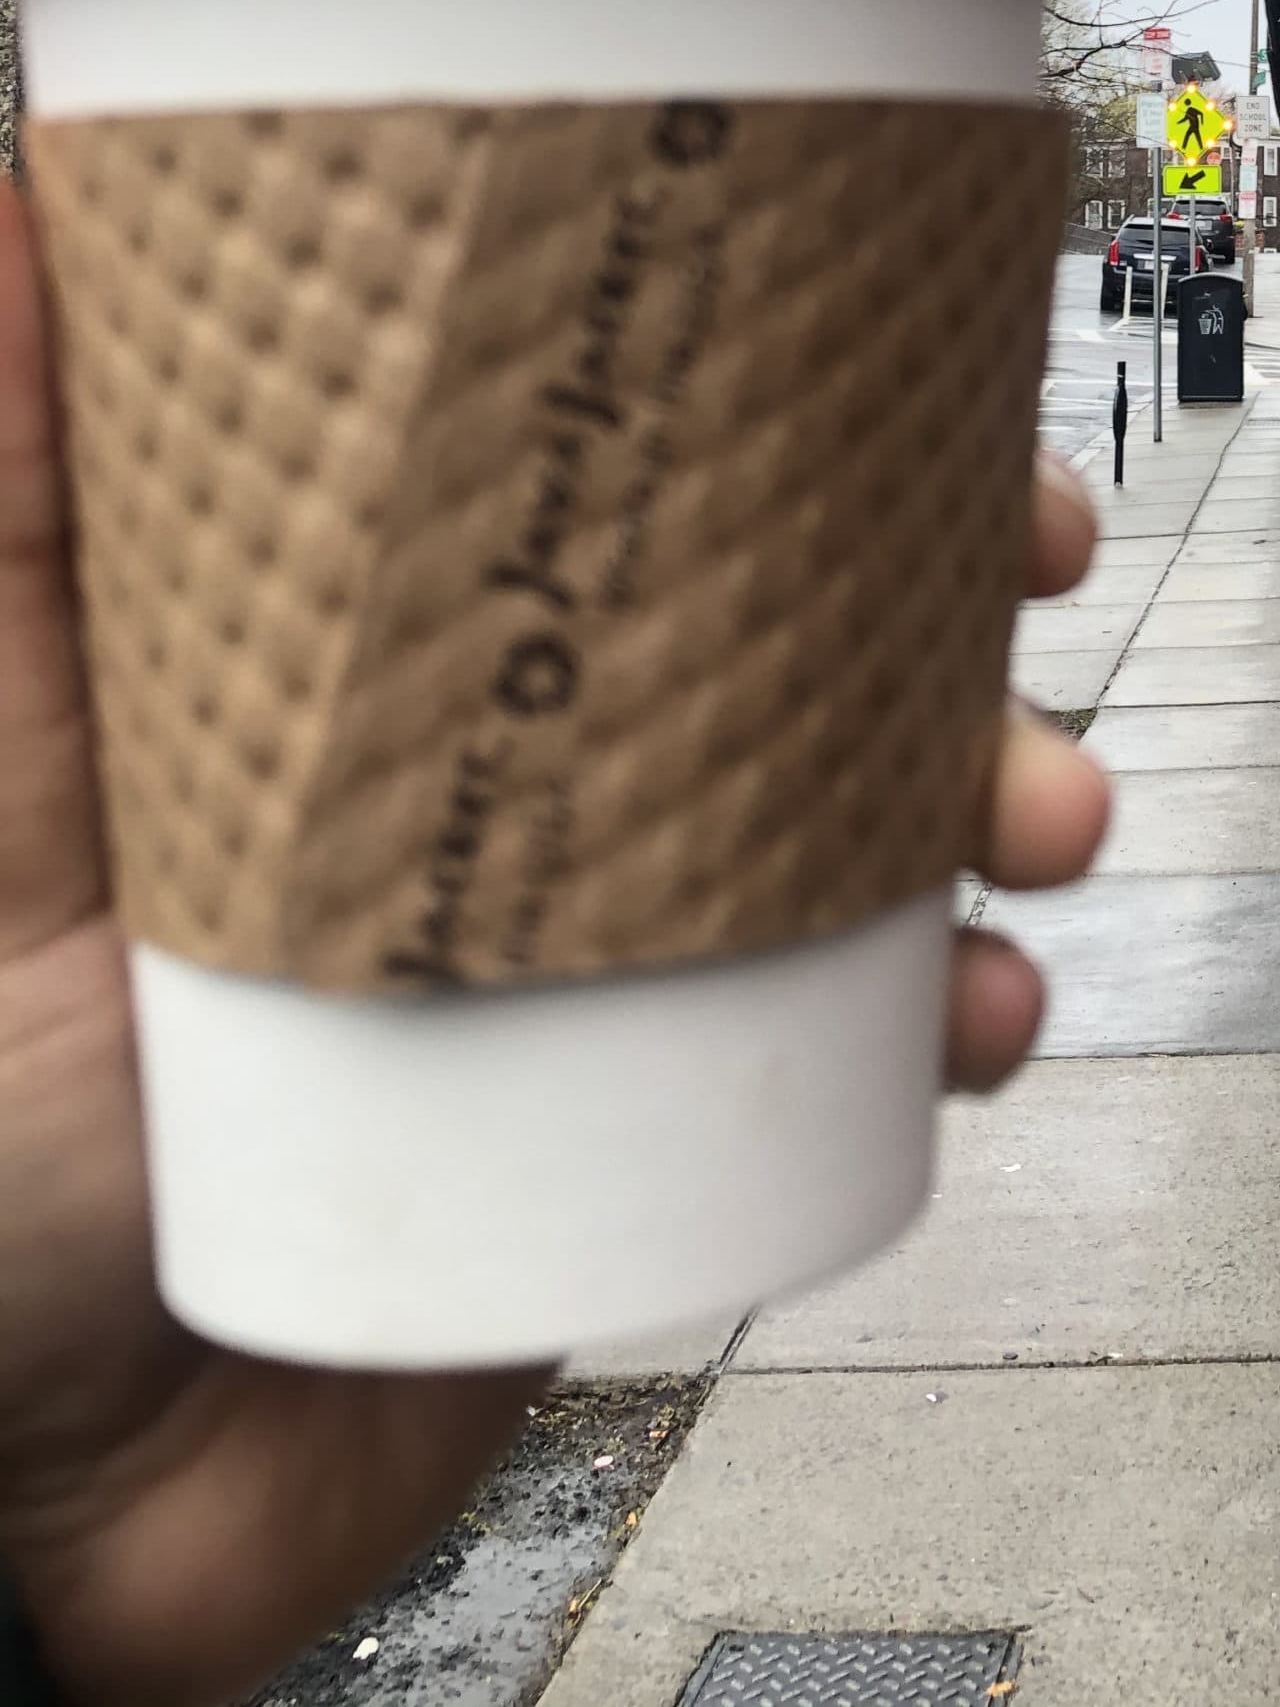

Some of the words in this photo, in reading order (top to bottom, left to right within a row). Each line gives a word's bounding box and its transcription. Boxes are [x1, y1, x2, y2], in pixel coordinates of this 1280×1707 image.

[1246, 102, 1261, 110] END
[1240, 113, 1267, 121] SCHOOL
[1244, 124, 1263, 133] ZONE
